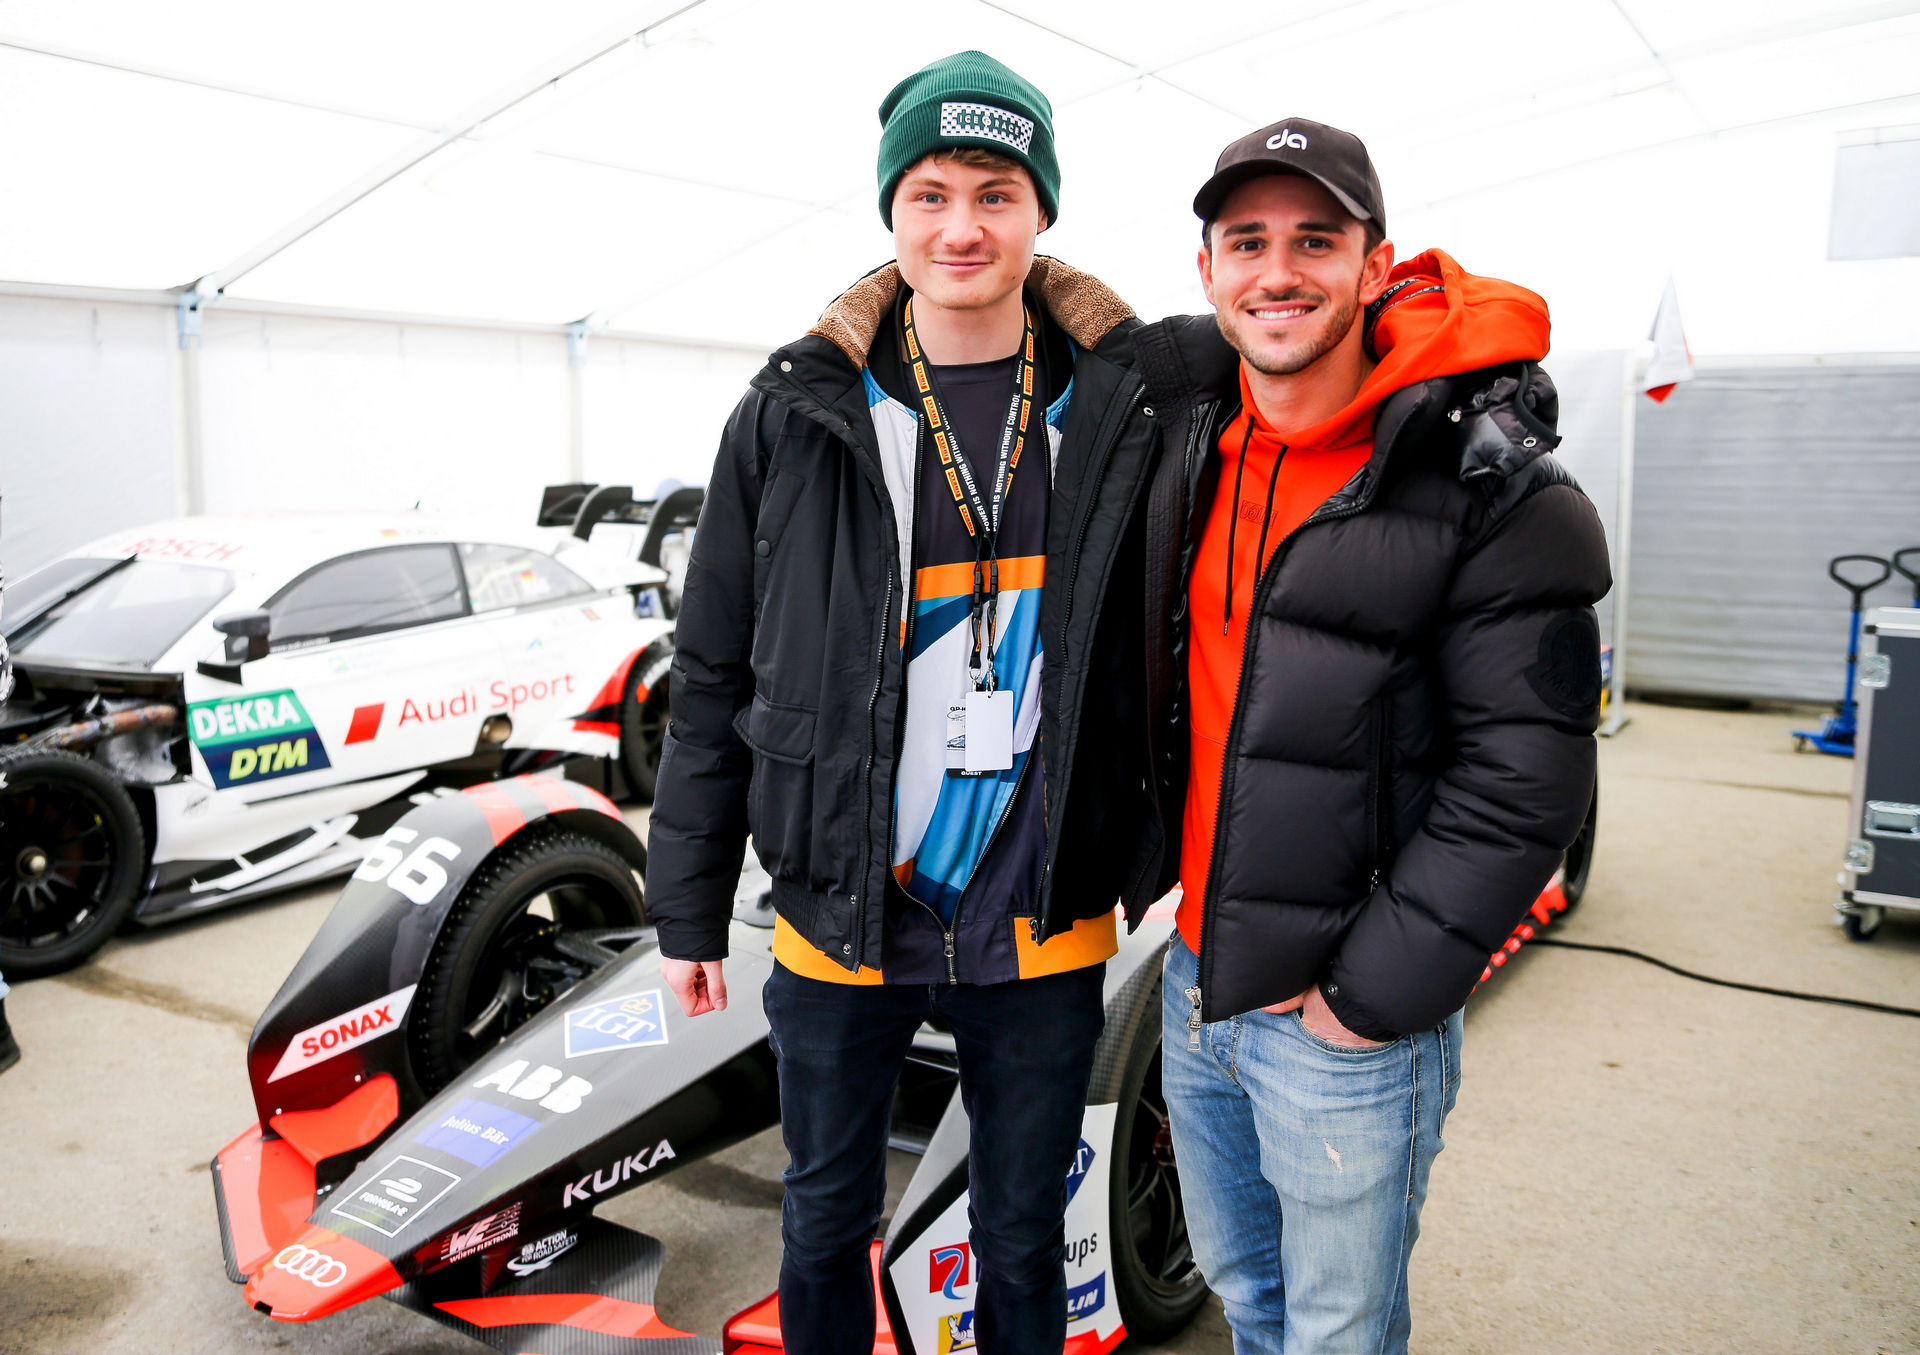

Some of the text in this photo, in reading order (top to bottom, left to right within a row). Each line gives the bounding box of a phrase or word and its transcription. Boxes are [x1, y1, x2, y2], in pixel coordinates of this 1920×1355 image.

[960, 115, 1020, 135] ICE RACE
[1266, 128, 1308, 150] da
[959, 463, 977, 496] NOTHING
[991, 394, 1021, 532] POWER IS NOTHING WITHOUT CONTROL
[972, 495, 981, 505] IS
[976, 505, 990, 532] POWER
[191, 693, 302, 740] DEKRA
[398, 673, 575, 727] Audi Sport
[229, 738, 309, 780] DTM
[354, 826, 462, 905] 66
[302, 1004, 393, 1058] SONAX
[574, 1007, 657, 1042] LGT
[473, 1059, 593, 1114] ABB
[563, 1139, 677, 1208] KUKA
[535, 1229, 567, 1251] ACTION
